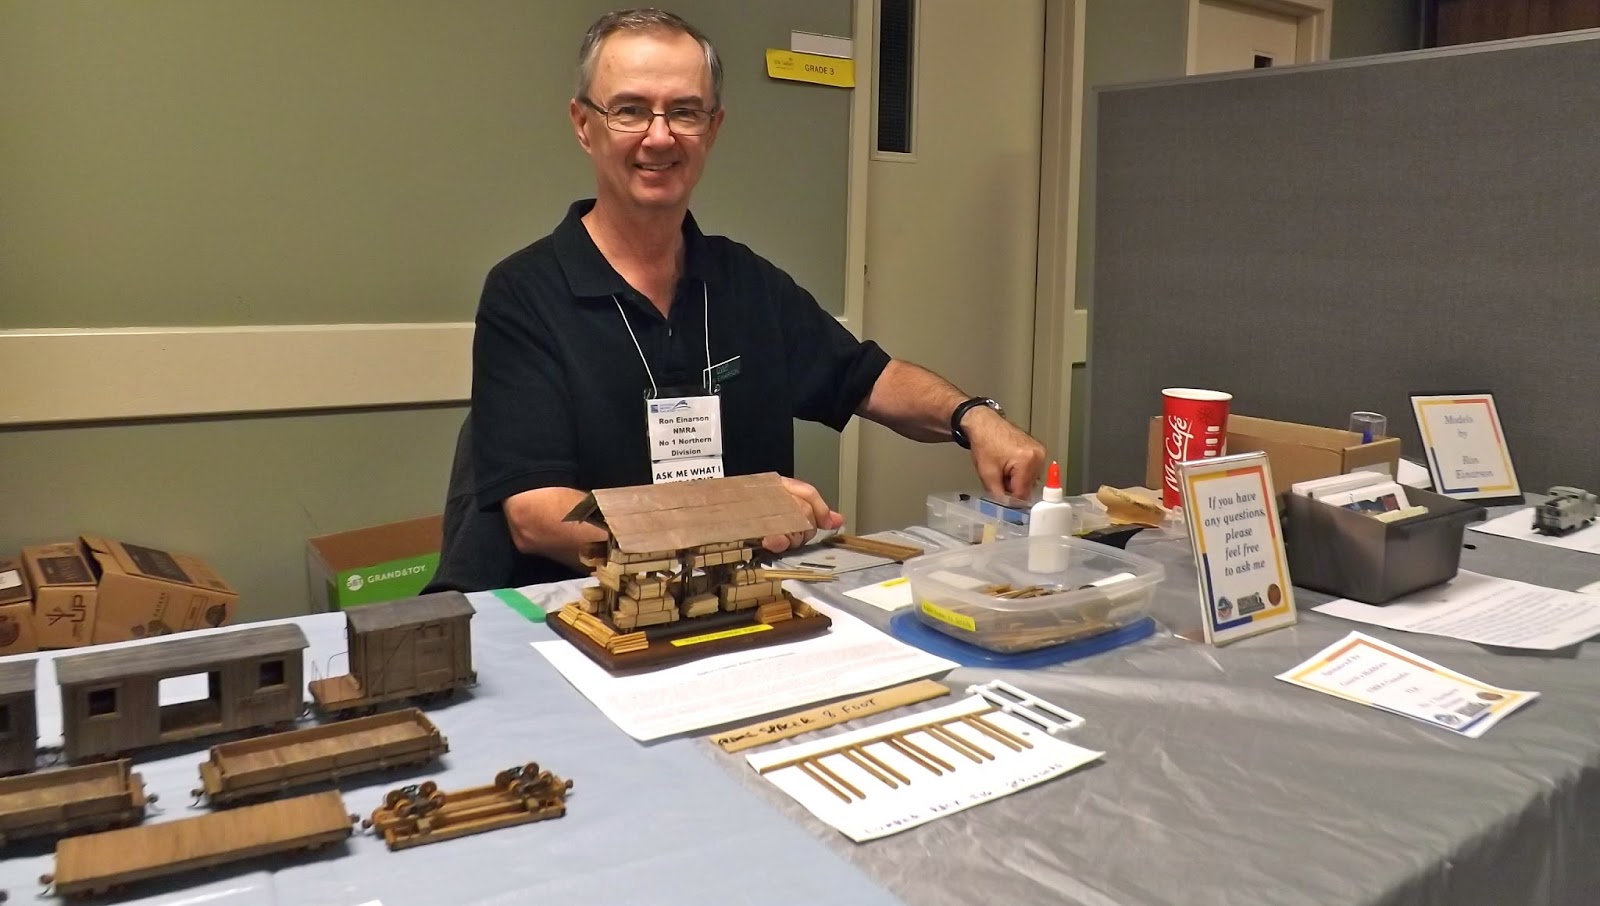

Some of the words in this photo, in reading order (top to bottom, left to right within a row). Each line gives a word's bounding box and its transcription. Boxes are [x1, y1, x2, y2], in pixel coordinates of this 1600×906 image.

[804, 63, 828, 74] GRADE
[676, 416, 709, 424] Einarson
[1444, 415, 1474, 425] Models
[1457, 428, 1468, 440] by
[679, 437, 712, 445] Northern
[671, 448, 702, 457] Division
[1462, 455, 1480, 465] Ron
[656, 471, 673, 480] ASK
[676, 469, 688, 477] ME
[690, 465, 716, 476] WHAT
[1208, 496, 1217, 510] If
[1218, 497, 1234, 509] you
[1235, 492, 1257, 504] have
[1204, 516, 1221, 527] any
[1225, 527, 1253, 543] please
[1225, 544, 1241, 561] feel
[1243, 543, 1260, 557] free
[1225, 565, 1234, 576] to
[1235, 561, 1251, 574] ask
[1253, 560, 1266, 570] me
[367, 565, 426, 583] GRAND&TOY
